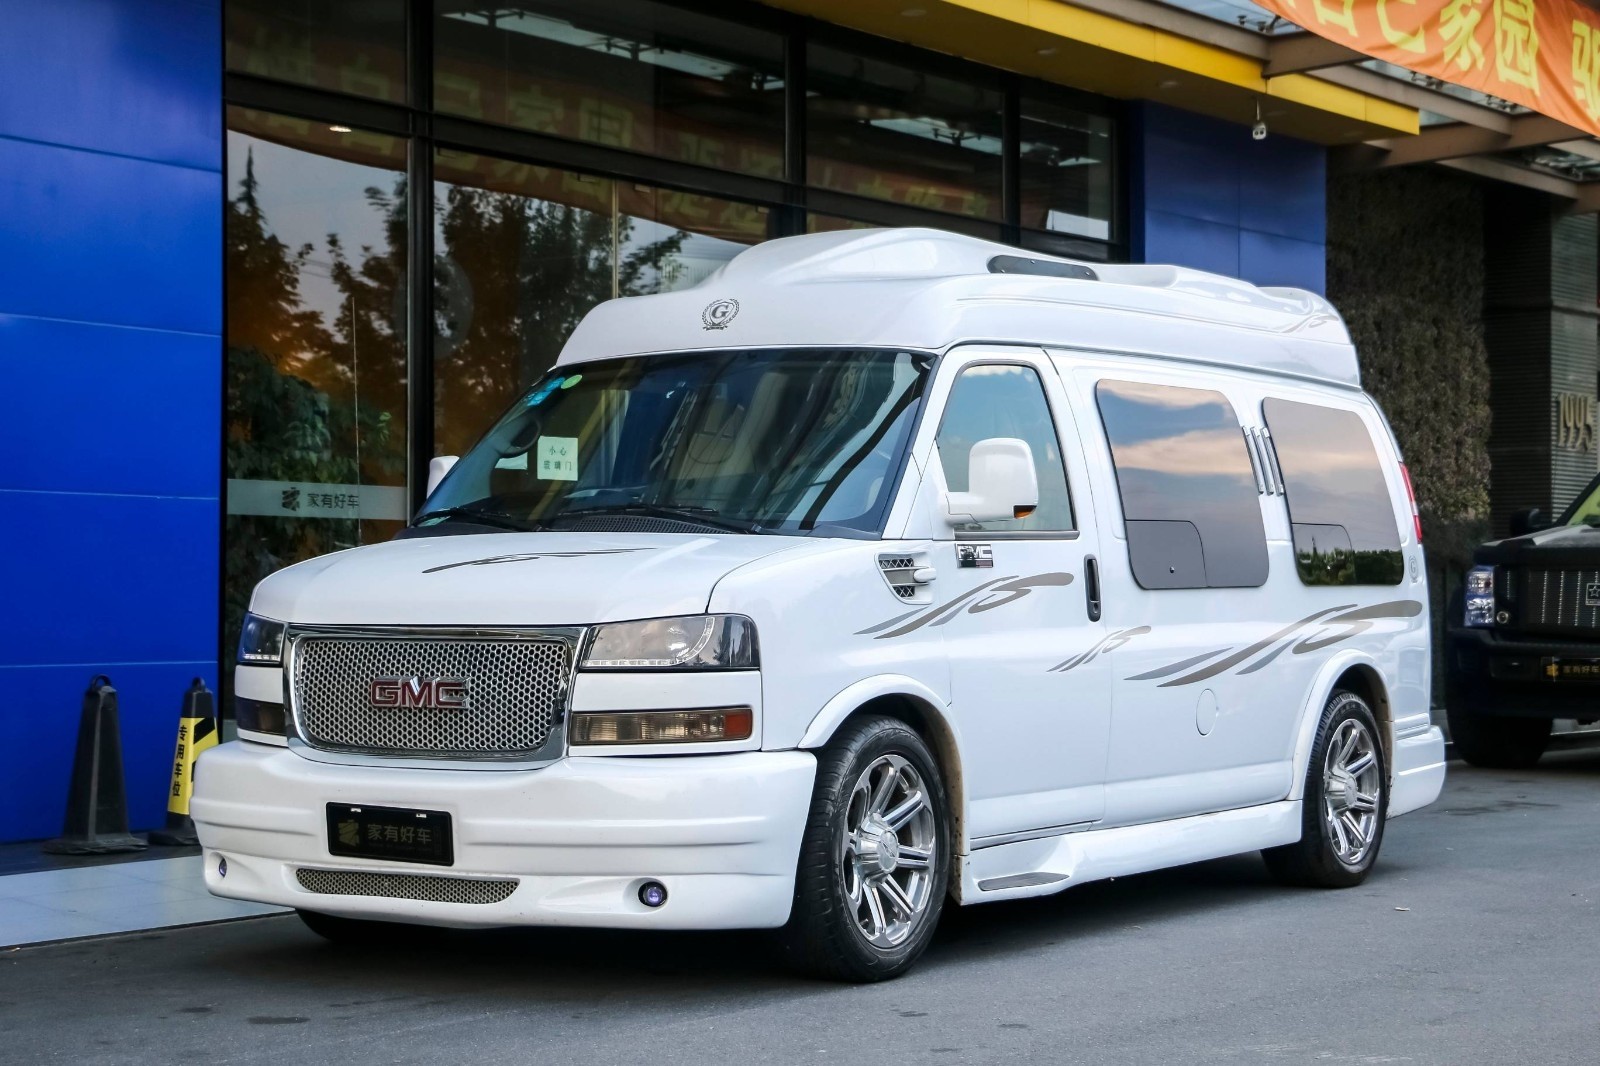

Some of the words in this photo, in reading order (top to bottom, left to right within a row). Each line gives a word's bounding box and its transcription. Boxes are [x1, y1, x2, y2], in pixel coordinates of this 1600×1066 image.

[549, 446, 567, 456] 小心
[307, 493, 359, 509] 家有好车
[371, 676, 469, 708] GMC
[172, 724, 188, 797] 专用车位
[367, 823, 432, 845] 家有好车
